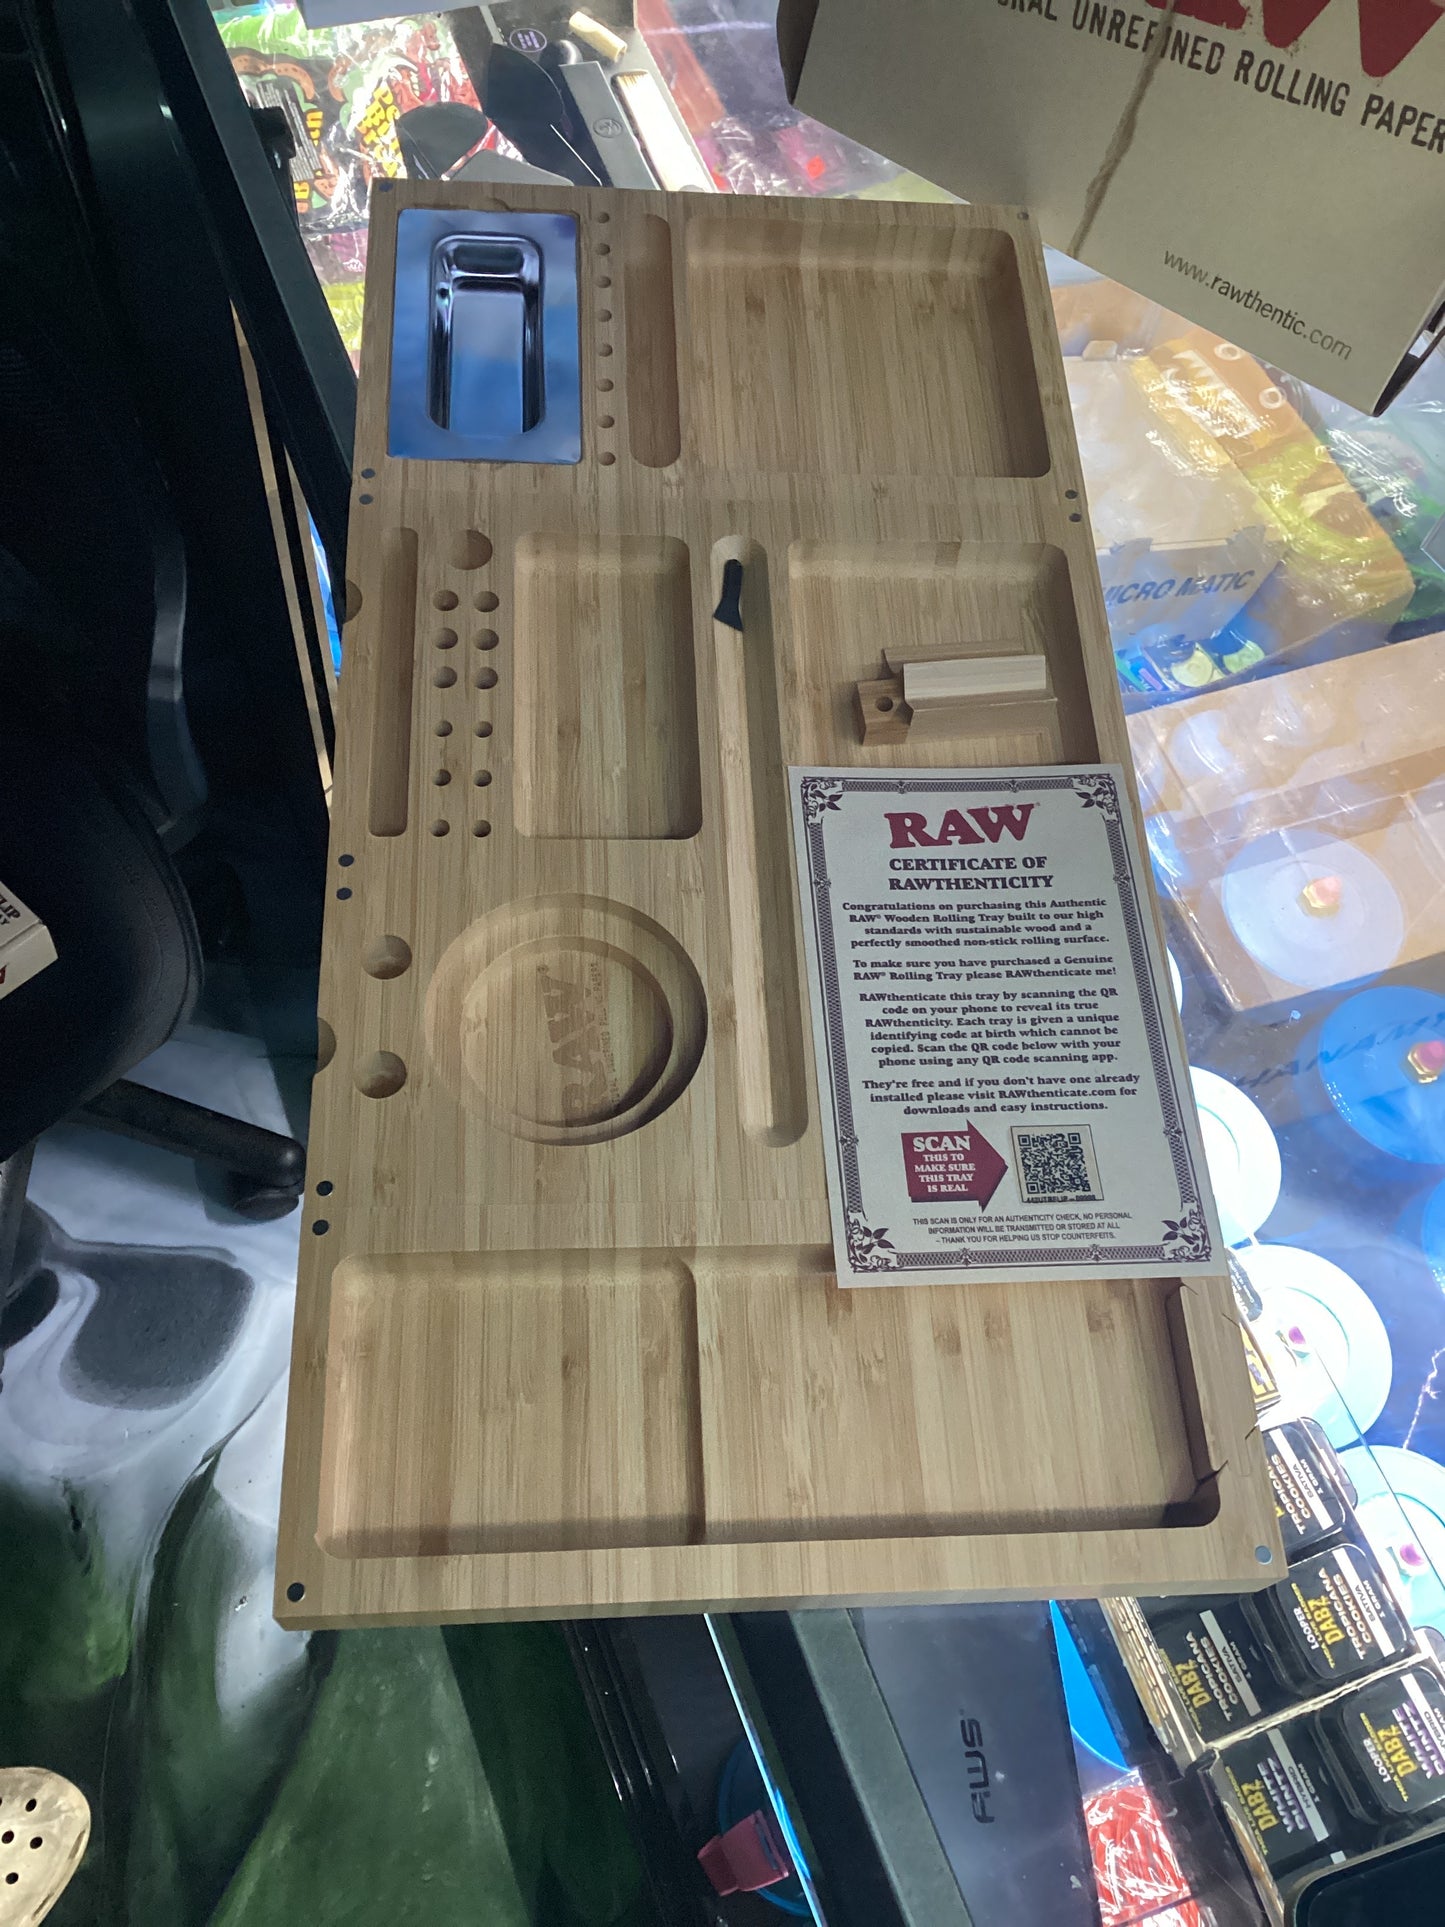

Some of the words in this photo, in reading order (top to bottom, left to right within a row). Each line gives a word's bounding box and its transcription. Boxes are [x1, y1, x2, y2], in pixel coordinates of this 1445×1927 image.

[1072, 3, 1224, 75] UNREFINED
[1233, 50, 1350, 116] ROLLING
[1360, 93, 1445, 154] PAPER
[1163, 250, 1353, 360] www.rawthentic.com
[889, 857, 1017, 871] CERTIFICATE
[1021, 856, 1047, 869] OF
[888, 874, 1054, 890] RAWTHENTICITY
[842, 902, 935, 912] Congratulations
[956, 901, 1022, 912] purchasing
[1024, 899, 1046, 908] this
[1049, 897, 1107, 908] Authentic
[883, 914, 930, 922] Wooden
[932, 913, 976, 924] Rolling
[977, 913, 1004, 923] Tray
[1007, 912, 1036, 921] built
[1076, 910, 1104, 920] high
[864, 926, 922, 934] standards
[924, 926, 952, 934] with
[955, 924, 1022, 934] sustainable
[1024, 923, 1056, 932] wood
[1059, 922, 1082, 931] and
[850, 938, 901, 949] perfectly
[905, 937, 960, 946] smoothed
[963, 936, 1018, 946] non-stick
[1020, 935, 1061, 946] rolling
[1063, 934, 1109, 943] surface.
[852, 959, 867, 968] To
[870, 959, 902, 968] make
[933, 960, 956, 969] you
[958, 958, 987, 967] have
[989, 956, 1050, 968] purchased
[1063, 954, 1113, 964] Genuine
[889, 971, 933, 982] Rolling
[935, 971, 963, 981] Tray
[965, 970, 1002, 981] please
[1004, 968, 1092, 978] RAWthenticate
[1094, 966, 1116, 975] me!
[859, 992, 946, 1001] RAWthenticate
[949, 991, 972, 1000] this
[975, 992, 1000, 1002] tray
[1002, 990, 1017, 1001] by
[1021, 989, 1075, 999] scanning
[1078, 988, 1097, 997] the
[1099, 987, 1118, 998] QR
[882, 1005, 908, 1014] code
[929, 1006, 958, 1016] your
[960, 1004, 997, 1015] phone
[1015, 1001, 1052, 1012] reveal
[1055, 1001, 1070, 1010] its
[864, 1017, 953, 1028] RAWthenticity.
[956, 1016, 986, 1026] Each
[988, 1017, 1013, 1027] tray
[1016, 1015, 1027, 1024] is
[1030, 1015, 1063, 1026] given
[1076, 1013, 1119, 1024] unique
[870, 1030, 937, 1042] identifying
[940, 1030, 967, 1039] code
[970, 1030, 983, 1038] at
[984, 1028, 1016, 1038] birth
[1018, 1027, 1057, 1037] which
[1059, 1027, 1101, 1036] cannot
[1103, 1025, 1118, 1035] be
[871, 1043, 914, 1055] copied.
[917, 1043, 946, 1052] Scan
[948, 1042, 968, 1051] the
[970, 1042, 989, 1053] QR
[991, 1041, 1019, 1050] code
[1021, 1040, 1058, 1050] below
[1060, 1039, 1089, 1048] with
[1092, 1040, 1121, 1050] your
[878, 1057, 915, 1068] phone
[918, 1056, 953, 1067] using
[956, 1057, 979, 1066] any
[981, 1055, 1000, 1066] QR
[1003, 1054, 1030, 1063] code
[1033, 1052, 1089, 1063] scanning
[1091, 1053, 1118, 1063] app.
[861, 1079, 908, 1090] They're
[911, 1078, 934, 1088] free
[938, 1077, 961, 1087] and
[964, 1077, 974, 1086] if
[976, 1079, 1000, 1088] you
[1003, 1076, 1034, 1085] don't
[1036, 1076, 1066, 1084] have
[1094, 1073, 1140, 1084] already
[870, 1092, 923, 1102] installed
[926, 1091, 964, 1103] please
[967, 1090, 995, 1100] visit
[997, 1088, 1116, 1099] RAWthenticate.com
[1119, 1086, 1137, 1095] for
[903, 1104, 970, 1115] downloads
[973, 1103, 997, 1112] and
[1000, 1104, 1027, 1113] easy
[1030, 1100, 1108, 1111] instructions.
[912, 1135, 970, 1152] SCAN
[922, 1153, 948, 1162] THIS
[949, 1153, 964, 1161] TO
[914, 1163, 946, 1172] MAKE
[948, 1162, 976, 1171] SURE
[918, 1173, 944, 1182] THIS
[945, 1173, 973, 1181] TRAY
[927, 1184, 938, 1192] IS
[939, 1183, 968, 1192] REAL
[912, 1217, 928, 1225] THIS
[929, 1217, 949, 1225] SCAN
[950, 1216, 957, 1224] IS
[958, 1216, 976, 1224] ONLY
[977, 1215, 993, 1223] FOR
[1005, 1213, 1054, 1222] AUTHENTICITY
[1082, 1212, 1093, 1220] NO
[941, 1235, 965, 1243] THANK
[966, 1235, 981, 1243] YOU
[982, 1234, 998, 1242] FOR
[998, 1234, 1029, 1242] HELPING
[1030, 1233, 1040, 1241] US
[1271, 1454, 1311, 1519] COOKIES
[1333, 1574, 1372, 1644] COOKIES
[1355, 1585, 1376, 1622] SATIVA
[1307, 1596, 1346, 1645] DABZ
[1319, 1567, 1366, 1660] TROPICANA
[1293, 1606, 1320, 1650] LOOPER
[1186, 1630, 1233, 1721] TROPICANA
[1200, 1636, 1238, 1705] COOKIES
[1175, 1659, 1212, 1708] DABZ
[1377, 1724, 1418, 1777] DABZ
[1363, 1738, 1391, 1783] LOOPER
[1241, 1779, 1280, 1831] DABZ
